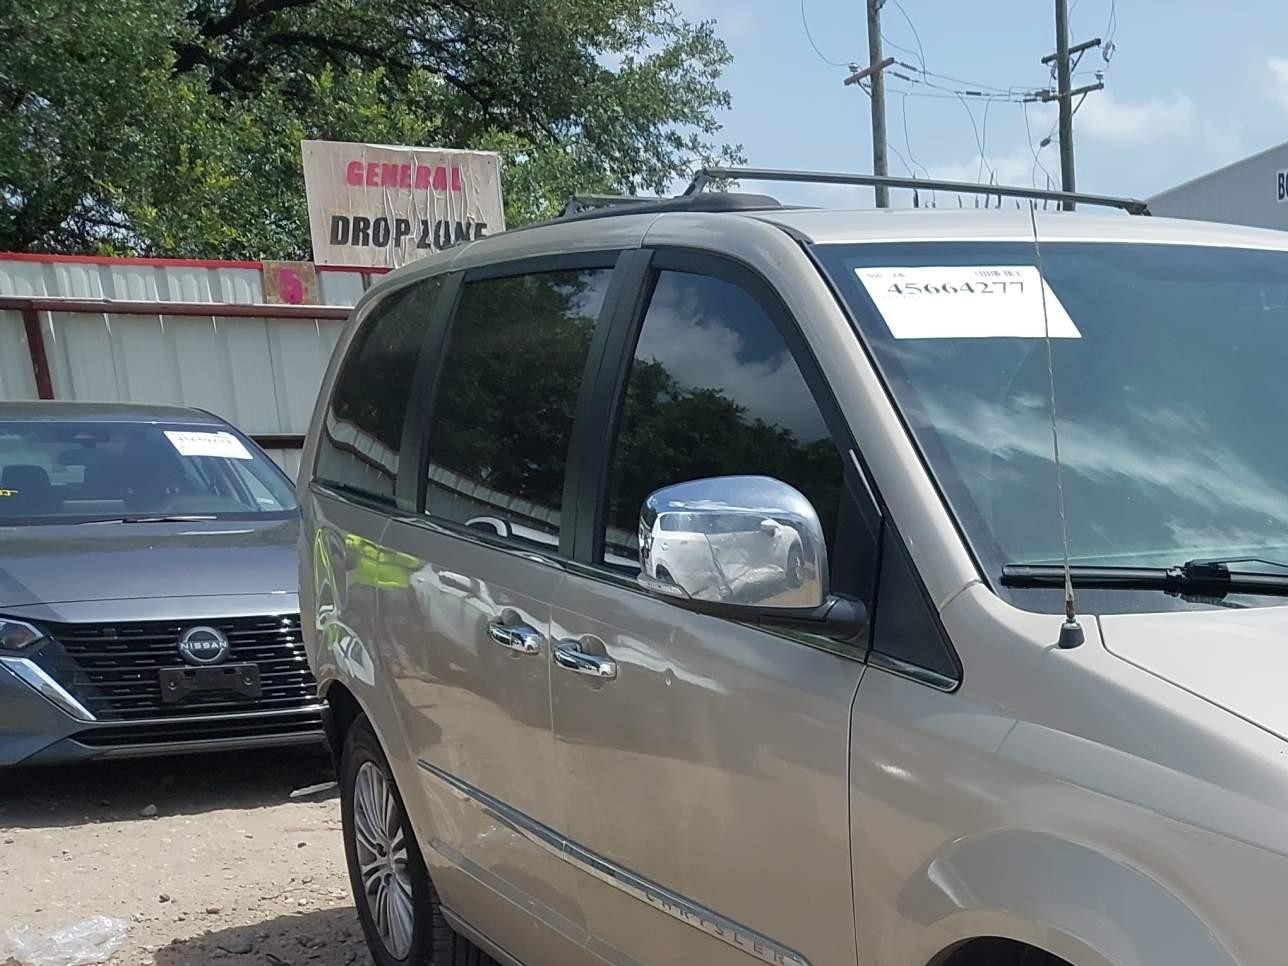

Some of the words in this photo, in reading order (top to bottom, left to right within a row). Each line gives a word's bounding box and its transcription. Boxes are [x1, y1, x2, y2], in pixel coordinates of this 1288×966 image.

[346, 161, 461, 191] GENERAL
[329, 215, 411, 248] DROP
[416, 219, 487, 250] ZONE
[887, 281, 1024, 295] 45664277
[180, 641, 227, 649] NISSAN
